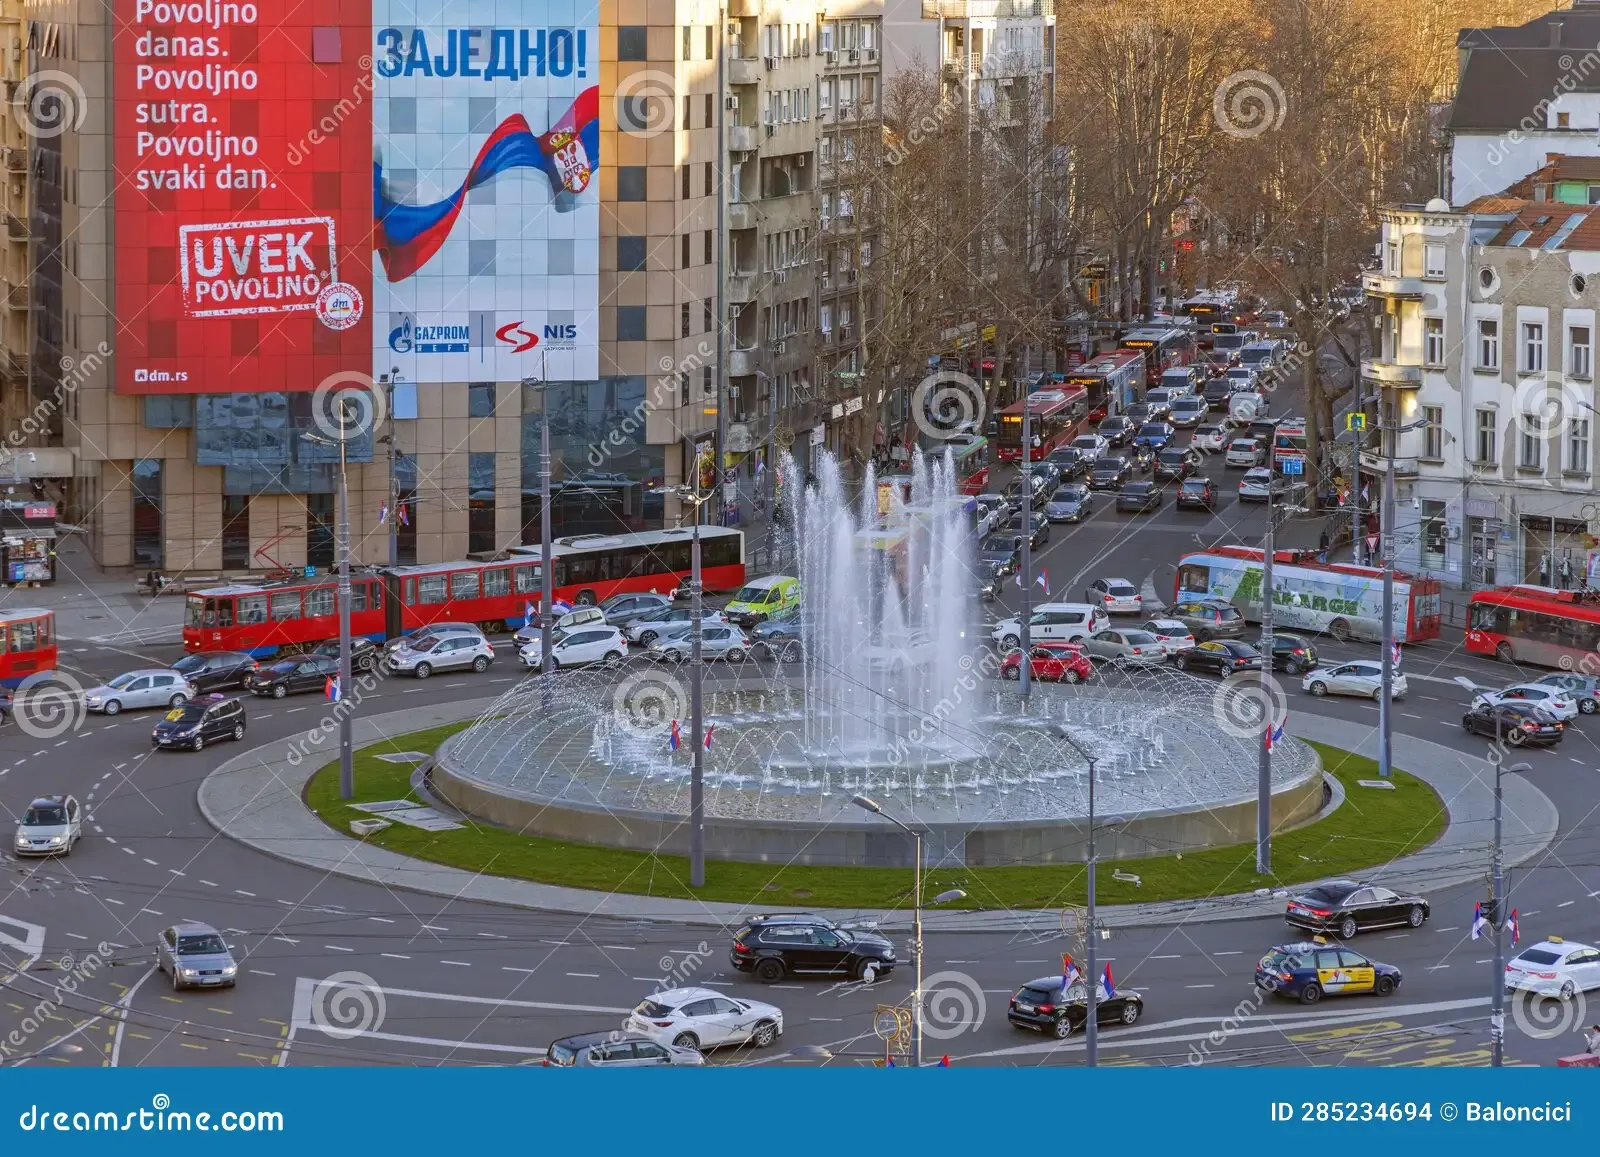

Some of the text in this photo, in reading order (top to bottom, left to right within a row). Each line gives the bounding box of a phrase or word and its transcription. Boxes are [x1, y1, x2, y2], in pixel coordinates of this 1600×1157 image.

[135, 0, 258, 28] Povoljno
[135, 30, 229, 58] danas.
[376, 27, 587, 82] ЗАЈЕДНО!
[136, 64, 258, 97] Povoljno
[135, 101, 218, 124] sutra.
[136, 130, 258, 163] Povoljno
[135, 163, 277, 190] svaki dan.
[193, 230, 317, 279] UVEK
[332, 299, 348, 308] dm
[415, 326, 470, 340] GAZPROM
[544, 325, 577, 339] NIS
[148, 369, 189, 382] dm.rs
